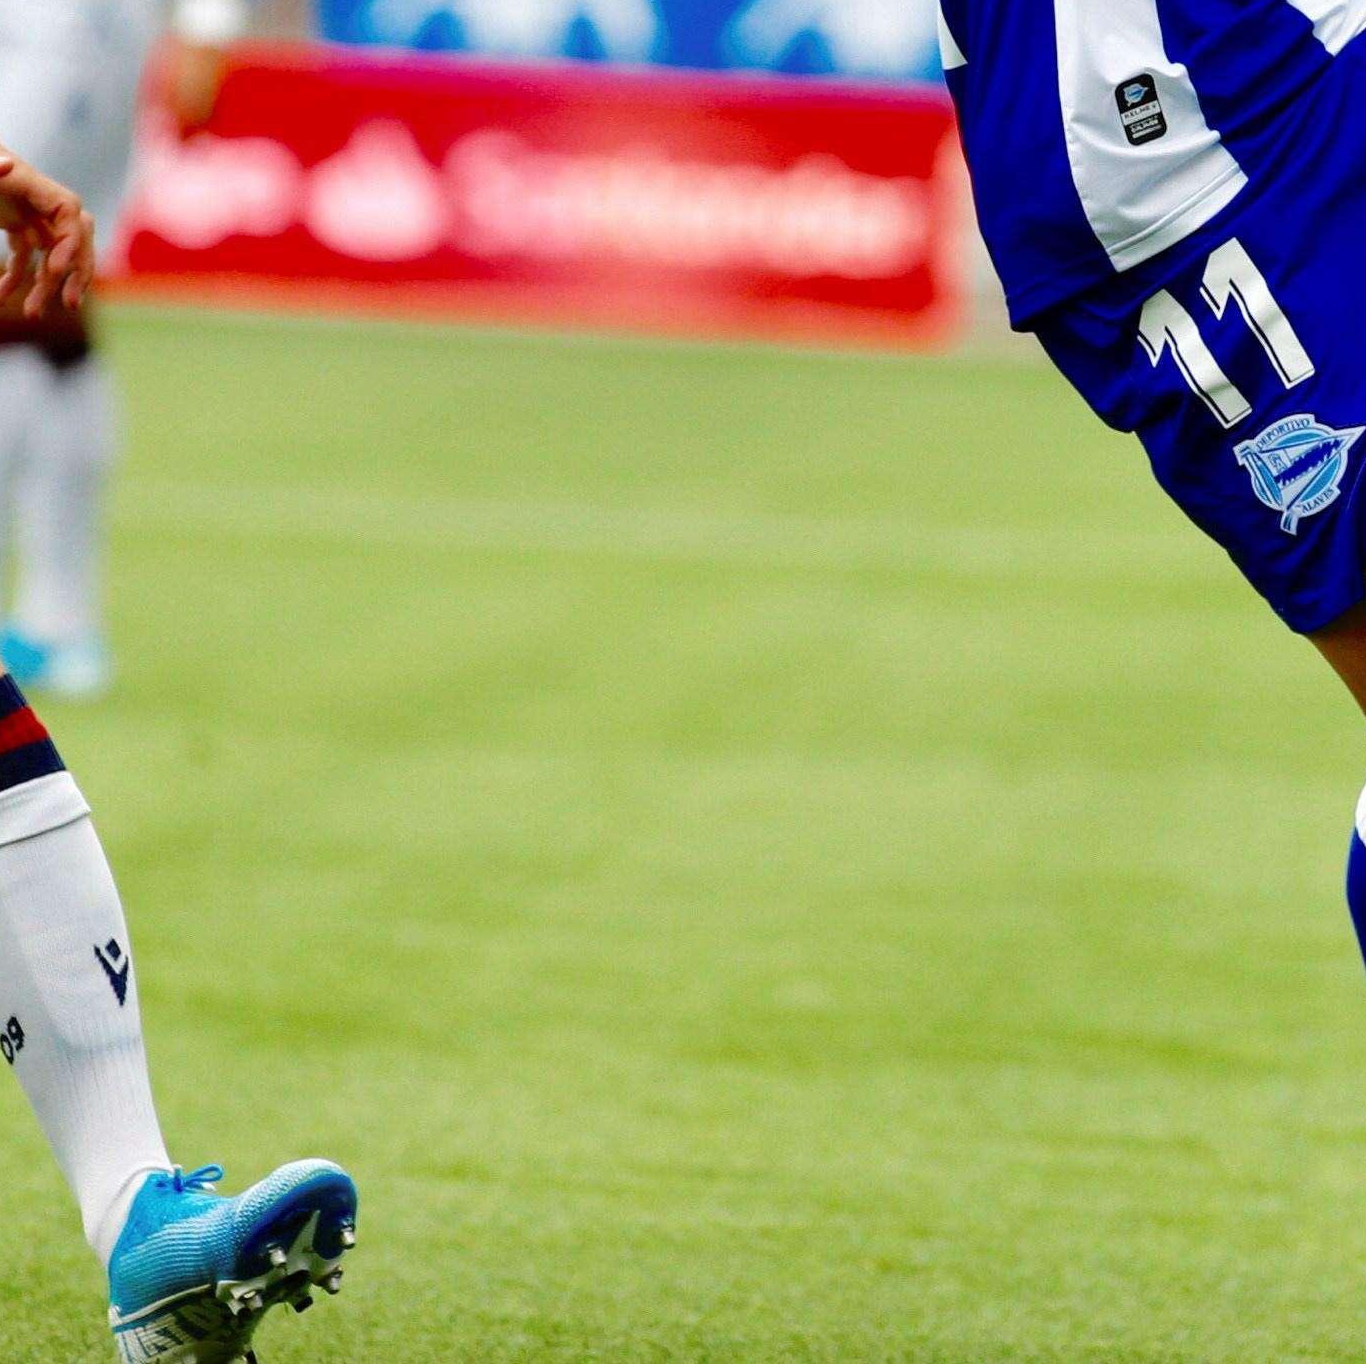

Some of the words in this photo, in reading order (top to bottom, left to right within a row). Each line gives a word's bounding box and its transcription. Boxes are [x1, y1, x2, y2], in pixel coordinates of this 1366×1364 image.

[1137, 237, 1315, 429] 11
[1256, 417, 1312, 450] DEPORTIVO
[0, 1016, 25, 1066] 09
